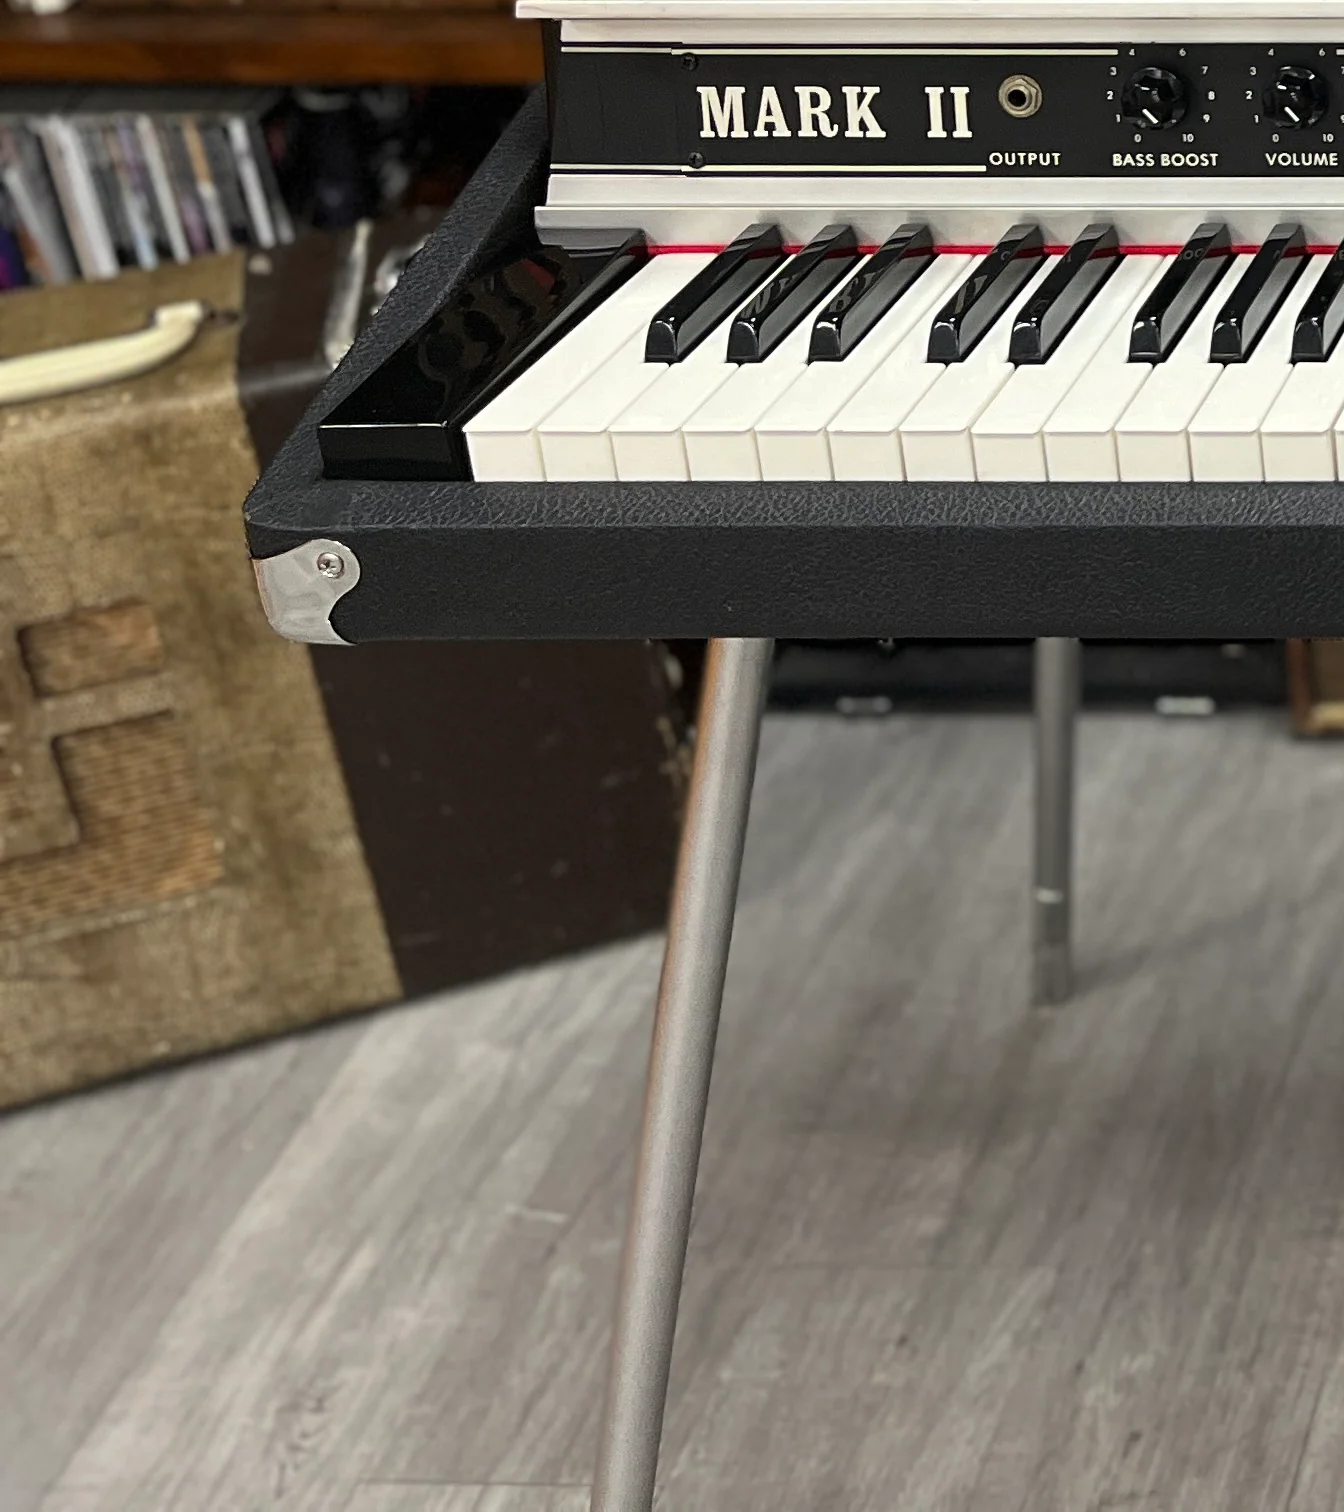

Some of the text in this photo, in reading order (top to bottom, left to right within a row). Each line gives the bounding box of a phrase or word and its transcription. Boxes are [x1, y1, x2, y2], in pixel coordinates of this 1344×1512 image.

[1128, 48, 1136, 57] 4
[1179, 47, 1187, 57] 6
[1267, 48, 1275, 57] 4
[1318, 47, 1326, 57] 6
[1110, 66, 1117, 76] 3
[1201, 66, 1209, 75] 7
[1249, 66, 1257, 76] 3
[1106, 90, 1114, 100] 2
[1207, 91, 1216, 100] 8
[1245, 90, 1253, 100] 2
[696, 85, 974, 139] MARK II
[1115, 114, 1121, 123] 1
[1203, 113, 1211, 123] 9
[1254, 114, 1260, 124] 1
[1134, 133, 1142, 143] 0
[1183, 133, 1194, 143] 10
[1272, 133, 1279, 143] 0
[1323, 133, 1334, 143] 10
[988, 152, 1061, 167] OUTPUT
[1112, 152, 1219, 167] BASS BOOST
[1265, 152, 1339, 167] VOLUME
